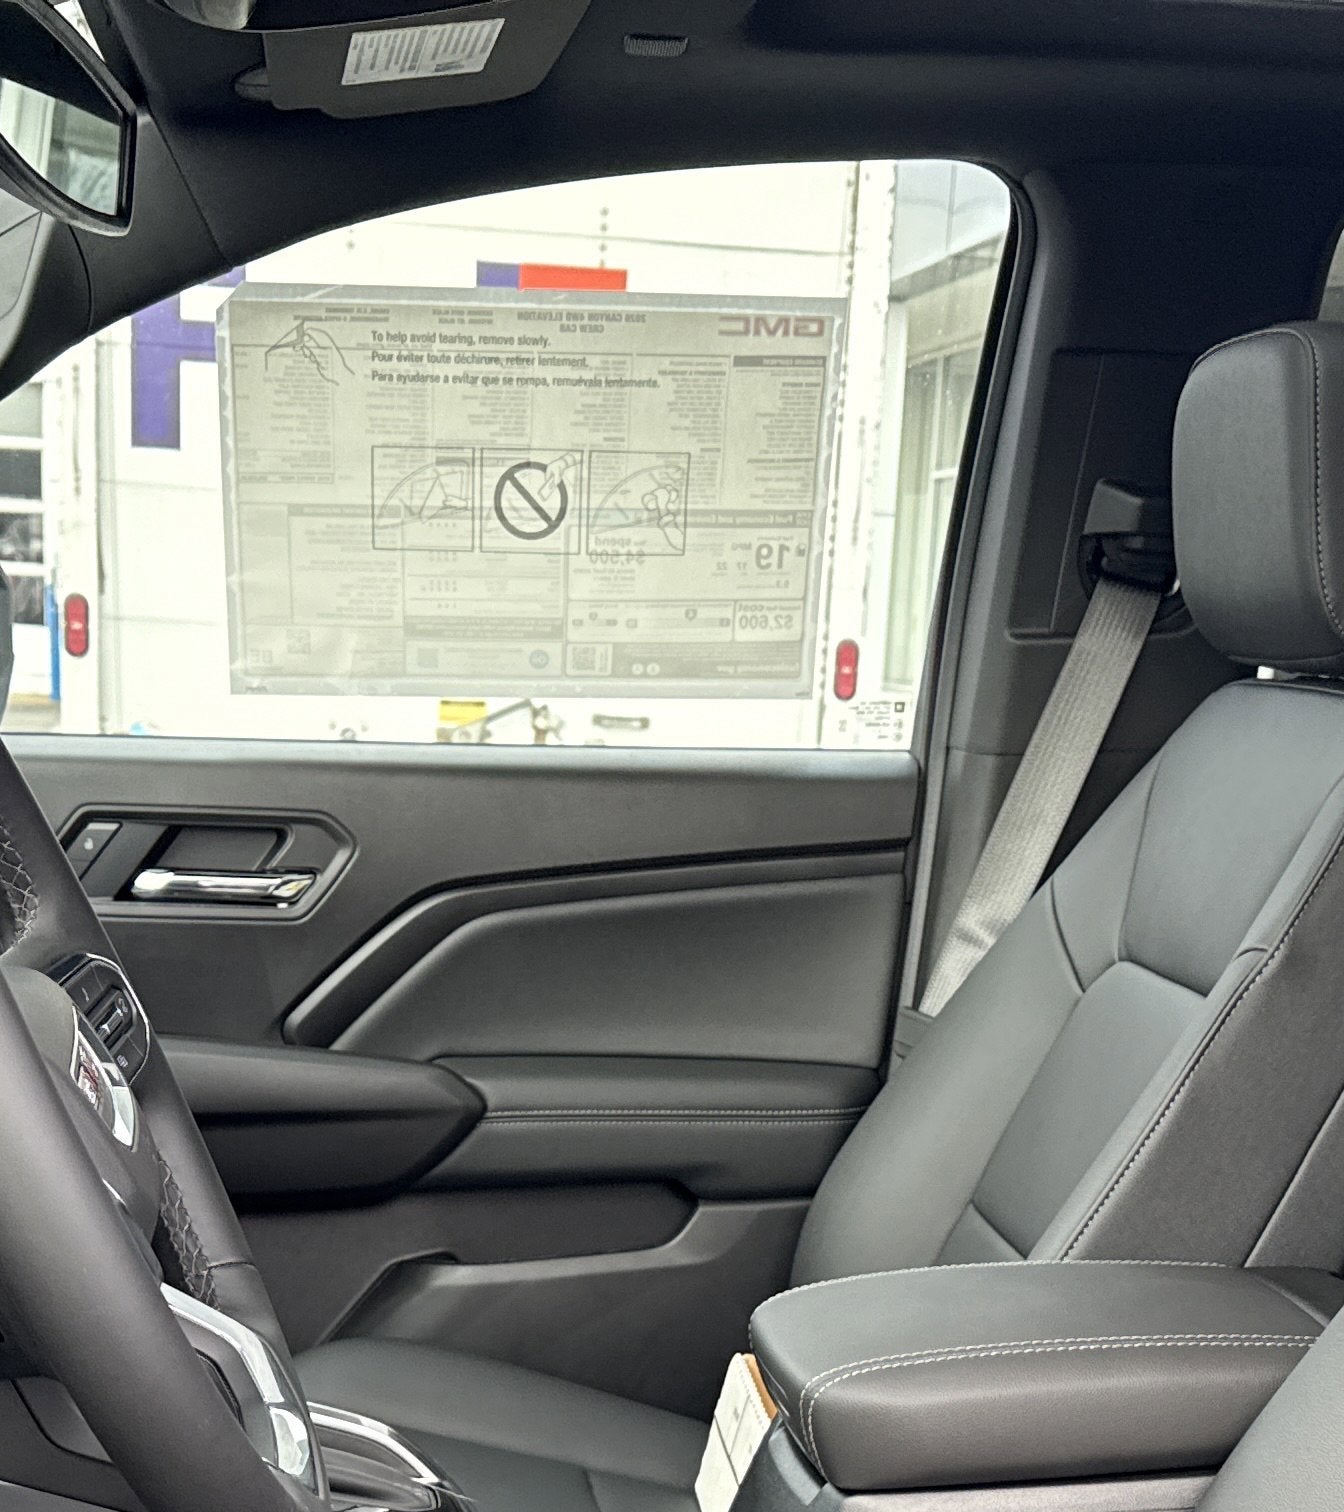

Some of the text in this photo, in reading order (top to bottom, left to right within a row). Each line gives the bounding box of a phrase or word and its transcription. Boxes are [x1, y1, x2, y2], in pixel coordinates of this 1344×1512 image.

[371, 331, 551, 348] To help avoid tearing, remove slowly.
[371, 351, 393, 362] Pour
[427, 353, 451, 364] toute
[506, 354, 535, 366] retirer
[371, 371, 394, 382] Para
[397, 372, 440, 386] ayudarse
[443, 374, 449, 383] a
[482, 376, 499, 388] que
[502, 376, 513, 385] se
[516, 376, 550, 388] rompa,
